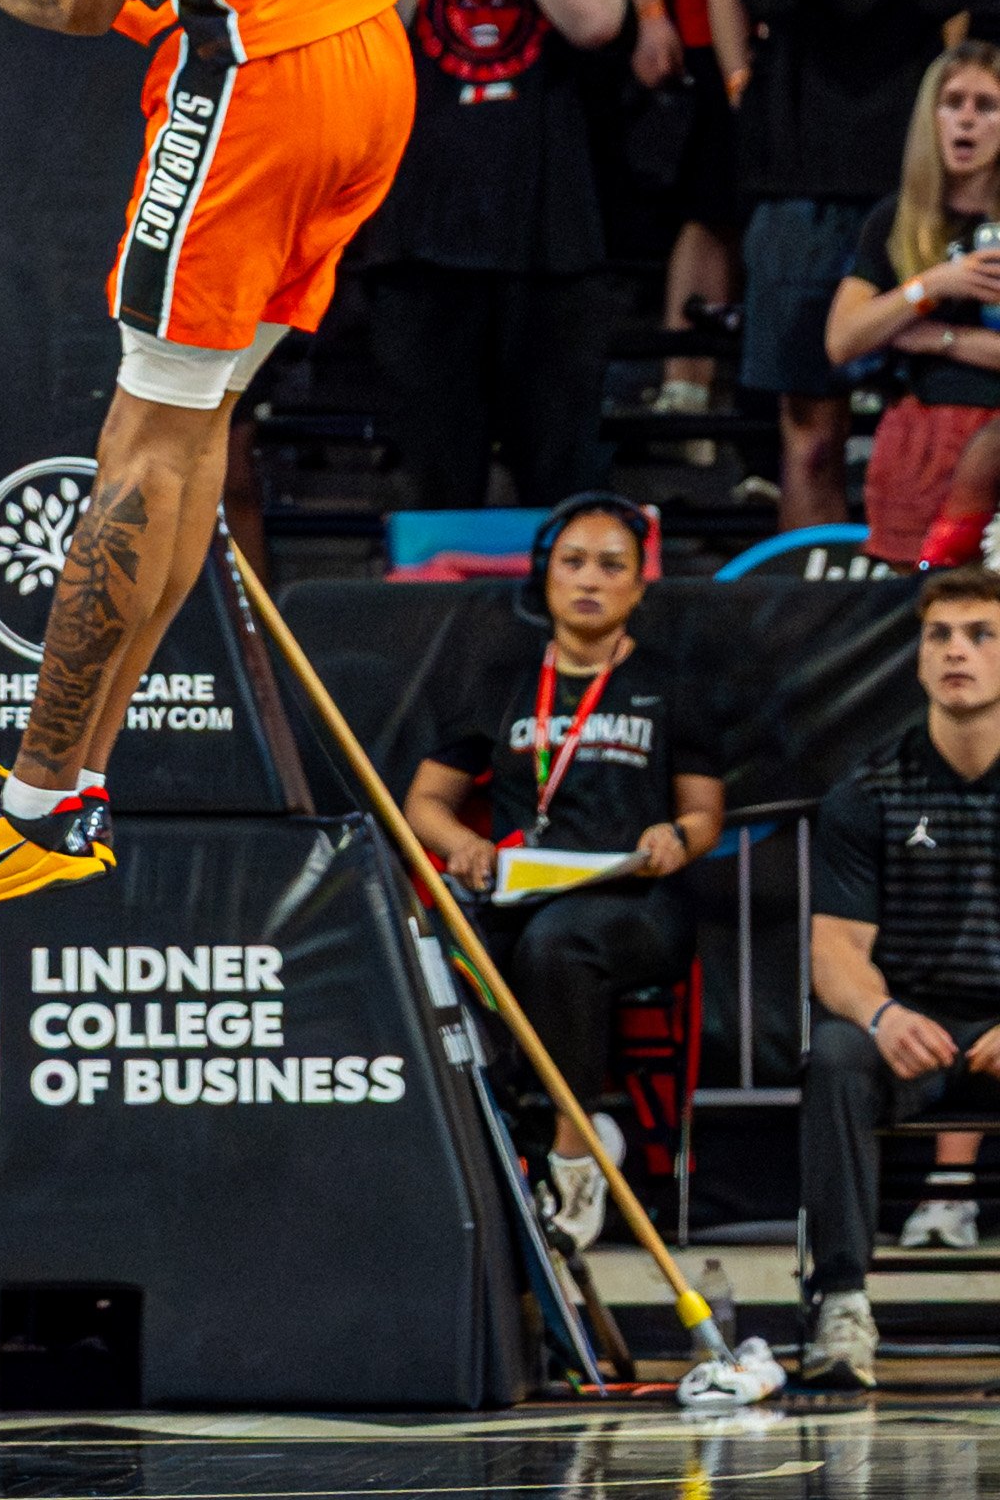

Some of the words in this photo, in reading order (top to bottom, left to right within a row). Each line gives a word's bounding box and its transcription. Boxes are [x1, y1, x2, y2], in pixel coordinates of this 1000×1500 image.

[135, 91, 215, 251] COWBOYS
[31, 945, 284, 993] LINDNER
[29, 1001, 285, 1049] COLLEGE
[29, 1058, 112, 1107] OF
[123, 1055, 407, 1105] BUSINESS
